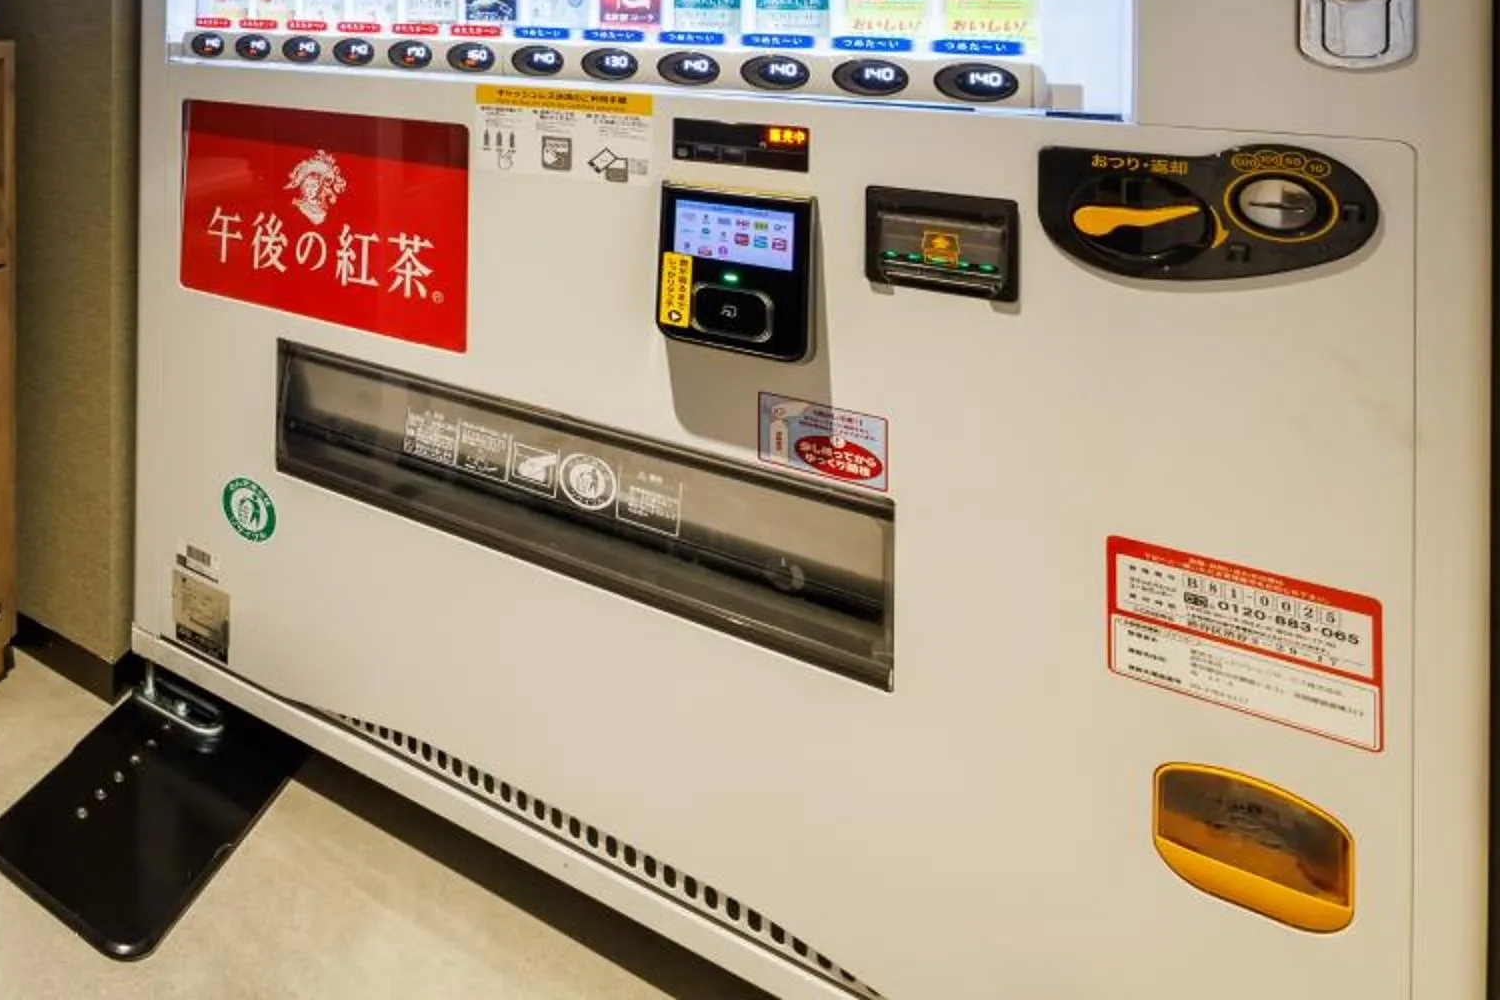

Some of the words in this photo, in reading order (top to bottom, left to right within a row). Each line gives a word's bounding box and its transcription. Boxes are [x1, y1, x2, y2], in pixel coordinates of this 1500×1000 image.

[350, 43, 369, 55] 140
[406, 46, 426, 58] 170
[467, 49, 488, 61] 160
[533, 51, 556, 65] 140
[604, 55, 629, 69] 130
[683, 58, 710, 73] 140
[769, 62, 798, 77] 140
[864, 66, 895, 82] 140
[969, 71, 1003, 87] 140
[769, 127, 806, 144] 販売中
[1090, 153, 1189, 176] おつり・返却
[1309, 163, 1325, 174] 10
[207, 206, 434, 299] 午後の紅茶
